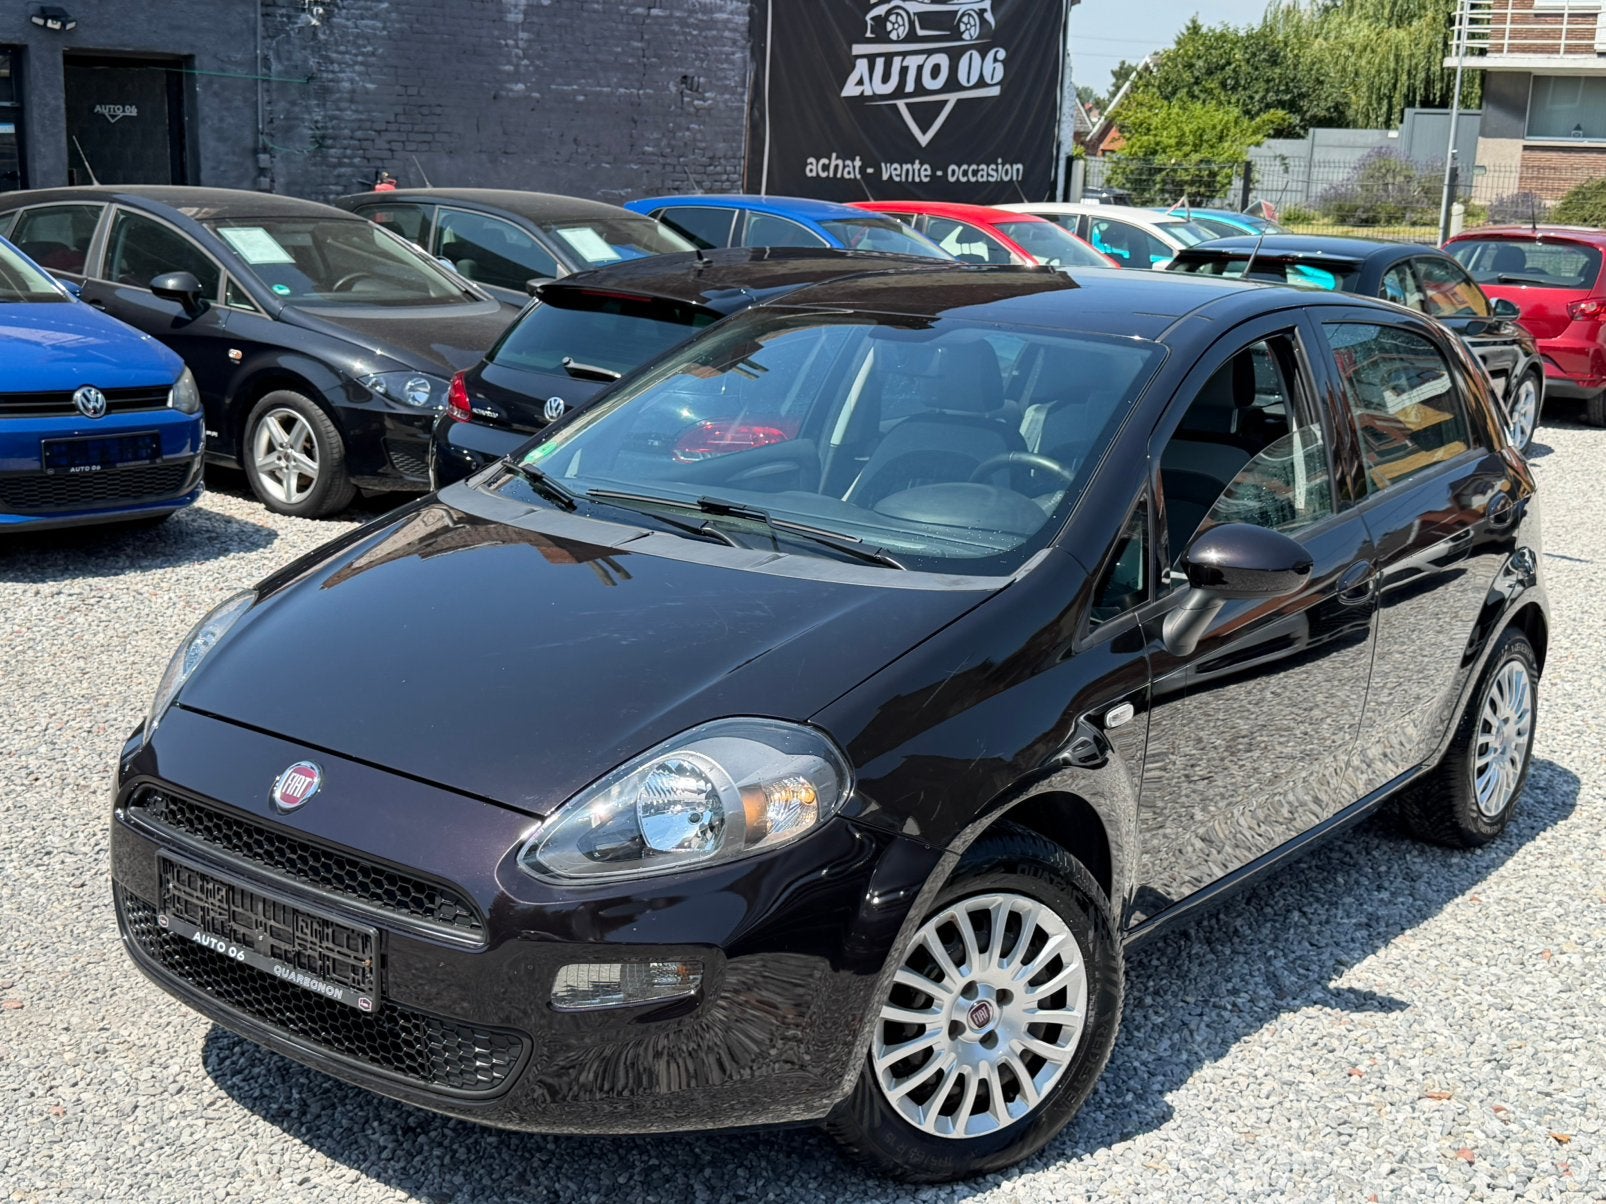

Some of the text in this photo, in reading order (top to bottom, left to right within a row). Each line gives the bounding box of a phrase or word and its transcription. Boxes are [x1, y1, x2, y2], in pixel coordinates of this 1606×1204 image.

[840, 47, 1007, 97] AUTO 06
[94, 104, 138, 114] AUTO 06
[805, 152, 862, 180] achat
[881, 159, 932, 183] vente
[947, 158, 1024, 183] occasion
[70, 465, 91, 473] AUTO
[281, 771, 314, 798] FIAT
[191, 931, 245, 961] AUTO 06
[971, 1005, 989, 1025] FIAT
